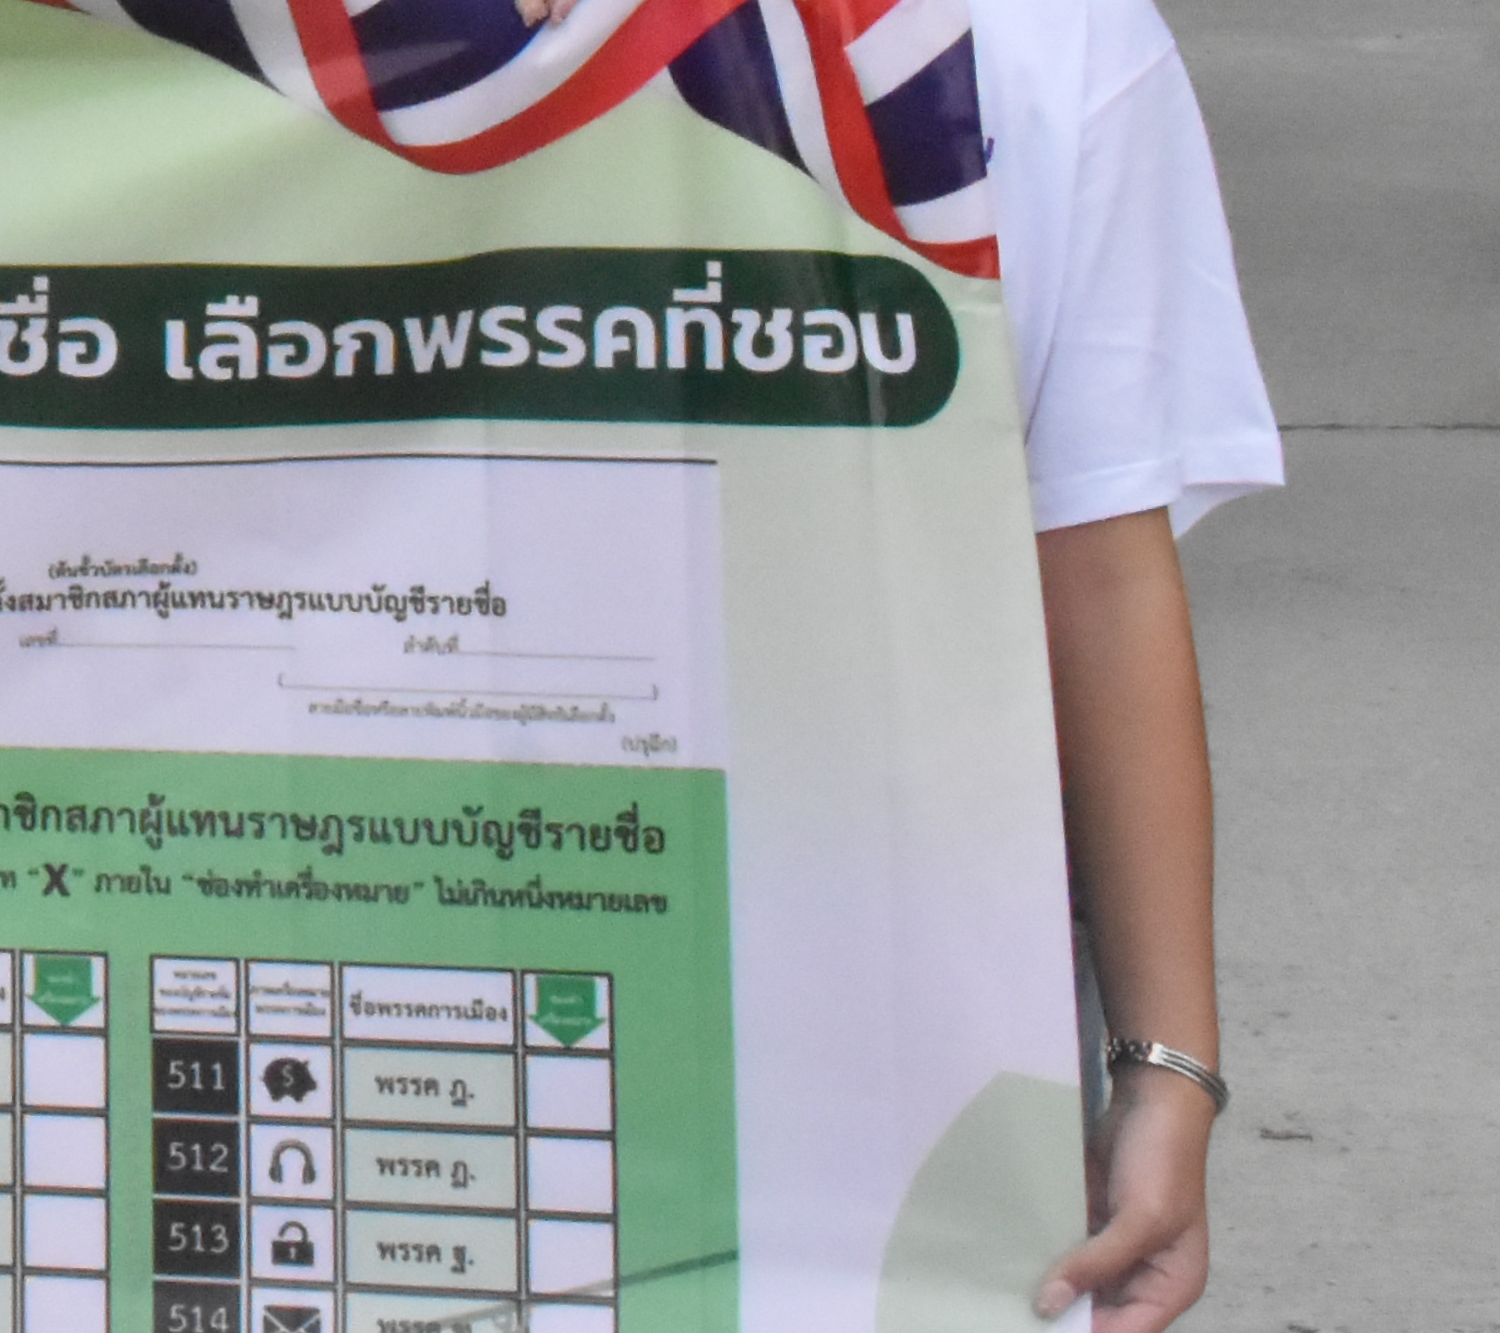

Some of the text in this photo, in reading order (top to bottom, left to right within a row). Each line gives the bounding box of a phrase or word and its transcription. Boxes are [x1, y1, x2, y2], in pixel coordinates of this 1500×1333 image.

[163, 264, 918, 385] เลือกพรรคที่ชอบ
[167, 1061, 227, 1091] 511
[374, 1073, 440, 1097] พรรค
[167, 1143, 229, 1173] 512
[376, 1155, 441, 1179] พรรค
[167, 1223, 229, 1253] 513
[377, 1239, 442, 1262] พรรค
